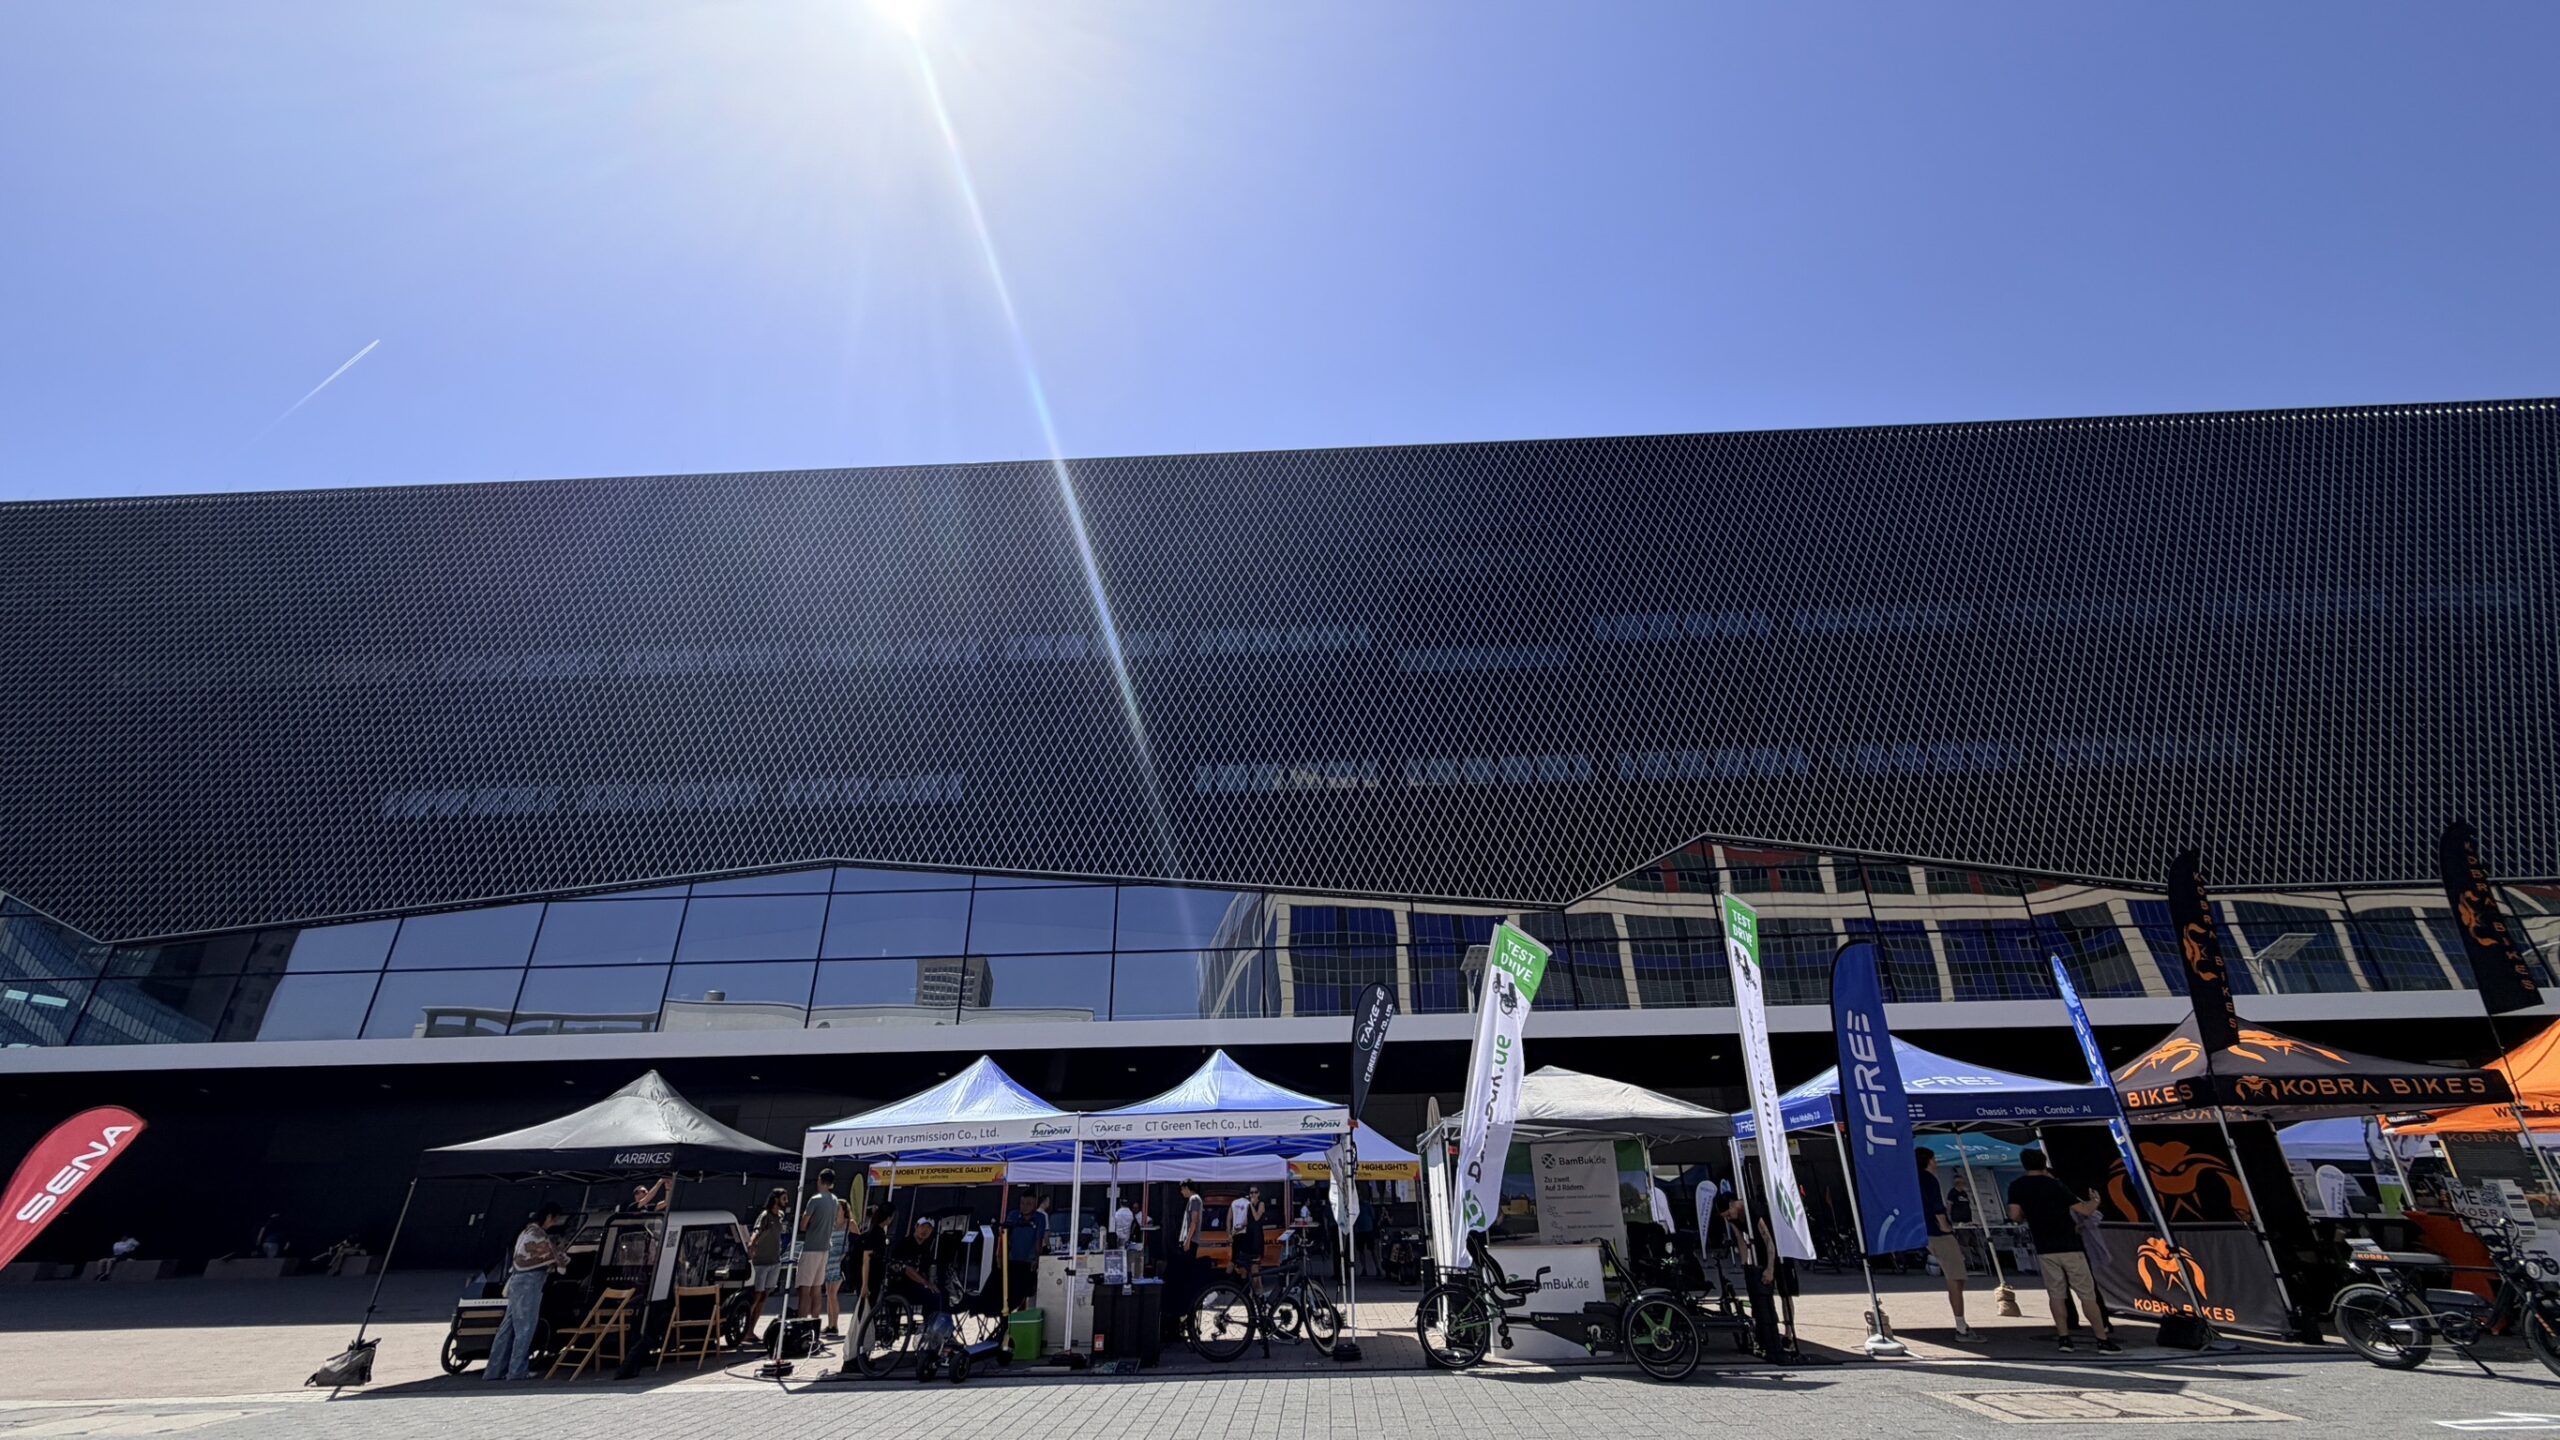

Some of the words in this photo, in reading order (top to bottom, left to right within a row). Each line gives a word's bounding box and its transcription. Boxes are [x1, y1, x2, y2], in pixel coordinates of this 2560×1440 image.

[1732, 908, 1751, 930] TEST
[1732, 923, 1753, 947] DRIVE
[1506, 939, 1537, 965] TEST
[1360, 986, 1385, 1044] TAKE-E
[1366, 1049, 1378, 1074] GREEN
[1363, 1072, 1372, 1083] CT
[1903, 1076, 2004, 1089] FREE
[2280, 1077, 2380, 1096] KOBRA
[2388, 1077, 2487, 1095] BIKES
[2126, 1083, 2195, 1107] BIKES
[1976, 1107, 2009, 1116] Chassis
[2015, 1106, 2038, 1116] Drive
[2043, 1105, 2075, 1115] Control
[1031, 1122, 1073, 1138] TAIWAN
[1094, 1123, 1133, 1132] TAKE-E
[1145, 1121, 1159, 1132] CT
[1160, 1120, 1192, 1131] Green
[1194, 1119, 1218, 1131] Tech
[1220, 1119, 1241, 1131] Co.,
[1243, 1117, 1263, 1129] Ltd.
[1300, 1115, 1341, 1131] TAIWAN
[843, 1136, 853, 1148] LI
[855, 1135, 884, 1147] YUAN
[887, 1131, 954, 1145] Transmission
[956, 1129, 978, 1142] Co.,
[980, 1127, 1000, 1139] Ltd.
[613, 1152, 673, 1165] KARBIKES
[16, 1125, 134, 1224] SENA
[882, 1168, 925, 1177] ECMOBILITY
[926, 1166, 963, 1175] EXPERIENCE
[964, 1166, 993, 1174] GALLERY
[1361, 1163, 1409, 1171] HIGHLIGHTS
[2451, 1189, 2480, 1206] ME
[1539, 1277, 1590, 1289] amBuk.de
[2183, 1304, 2236, 1322] BKES
